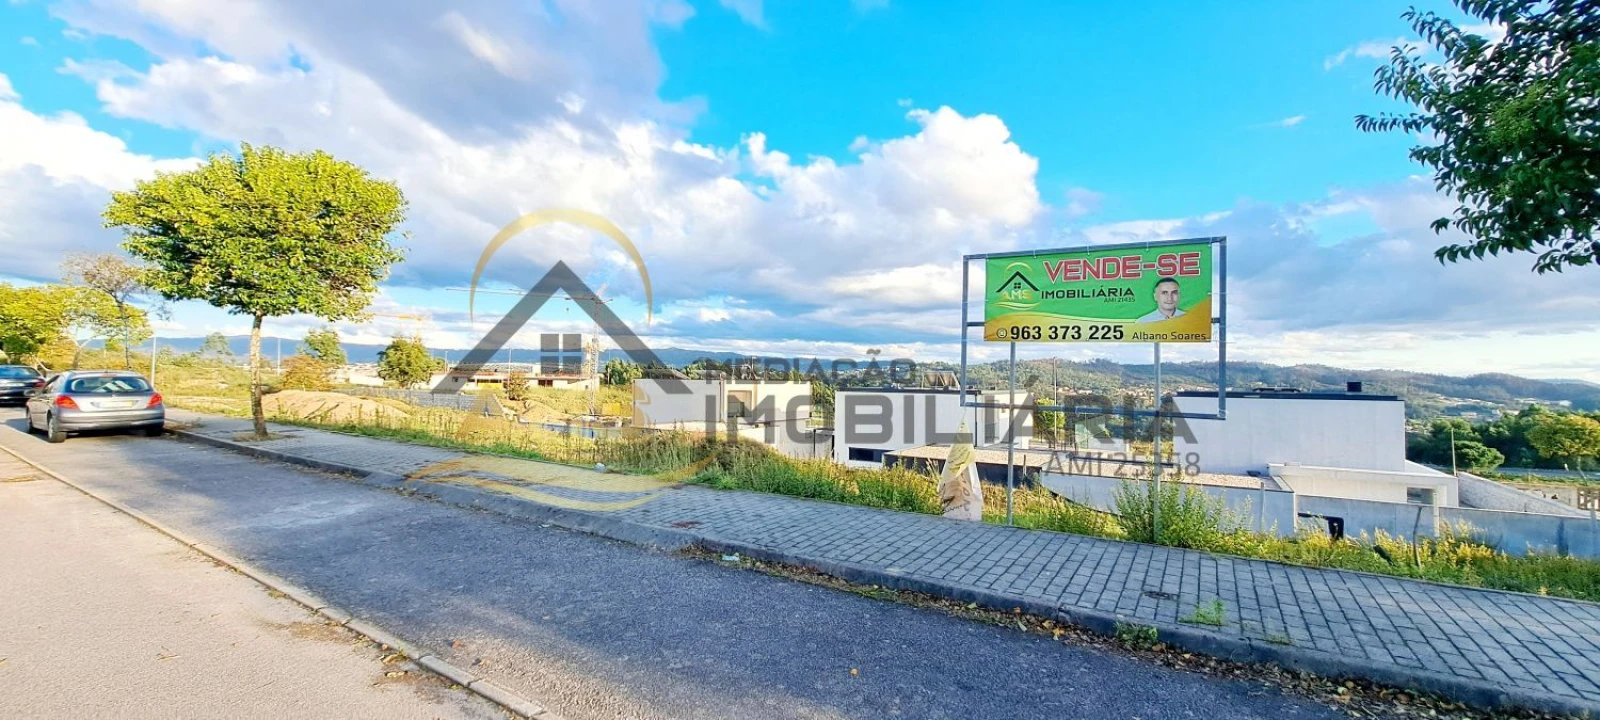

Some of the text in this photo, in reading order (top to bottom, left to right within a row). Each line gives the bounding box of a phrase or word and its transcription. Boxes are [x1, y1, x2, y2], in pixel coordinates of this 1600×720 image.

[1043, 252, 1201, 284] VENDE-SE
[1041, 285, 1135, 299] IMOBILIÁRIA
[1010, 325, 1124, 340] 963 373 225
[1132, 331, 1207, 341] Albano Soares
